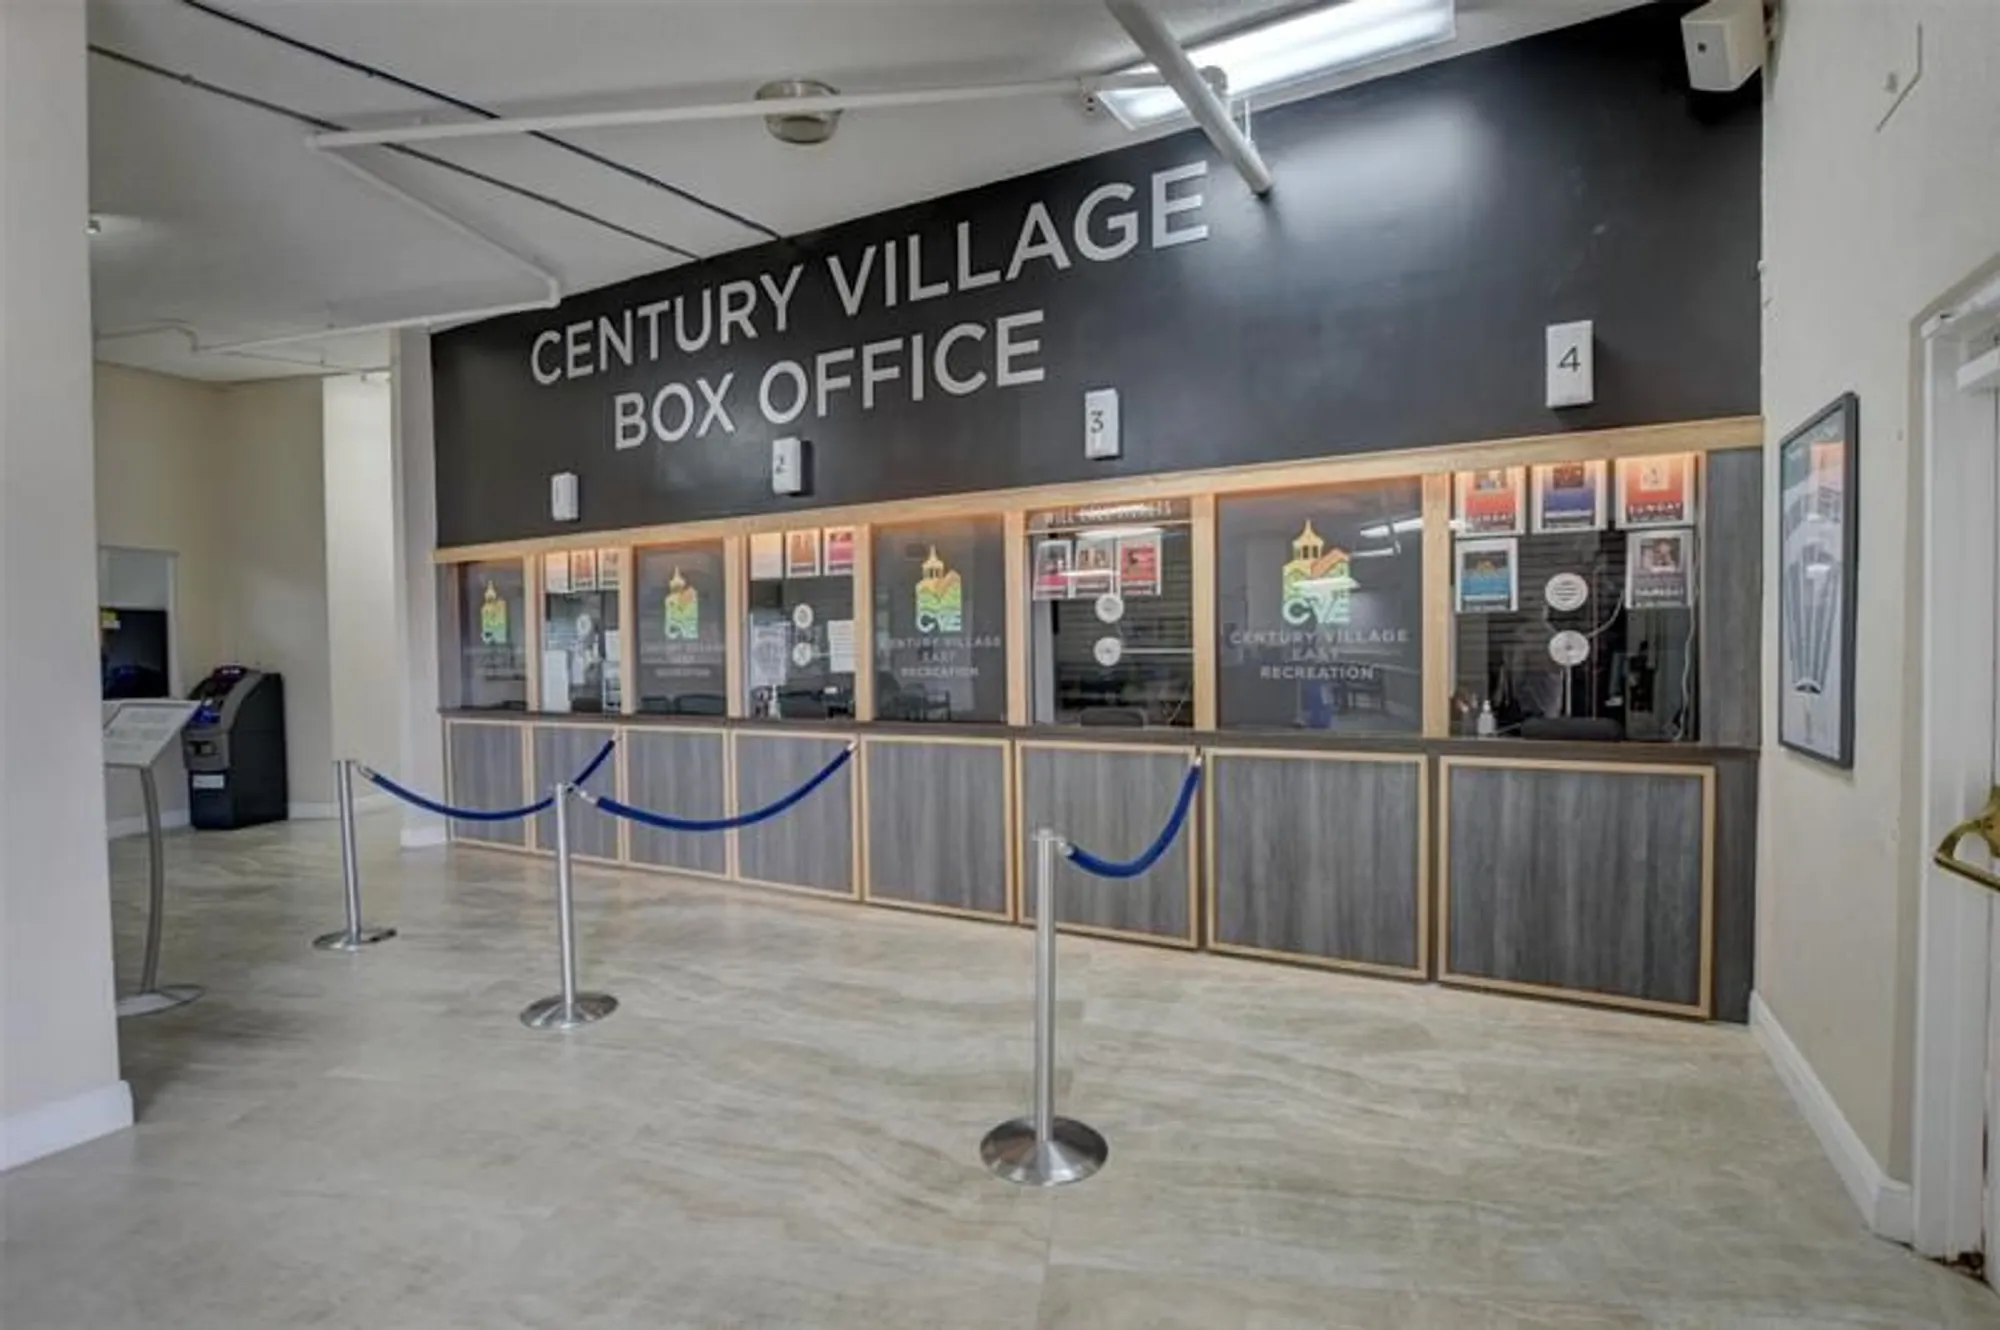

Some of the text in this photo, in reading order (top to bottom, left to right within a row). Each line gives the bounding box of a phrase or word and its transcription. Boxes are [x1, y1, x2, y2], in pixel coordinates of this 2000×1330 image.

[530, 161, 1209, 385] CENTURY VILLAGE
[1557, 344, 1581, 373] 4
[613, 310, 1044, 450] BOX OFFICE
[1090, 410, 1104, 434] 3
[1282, 594, 1351, 624] CVE
[1229, 628, 1409, 645] CENTURY VILLAGE
[1259, 664, 1375, 680] RECREATION
